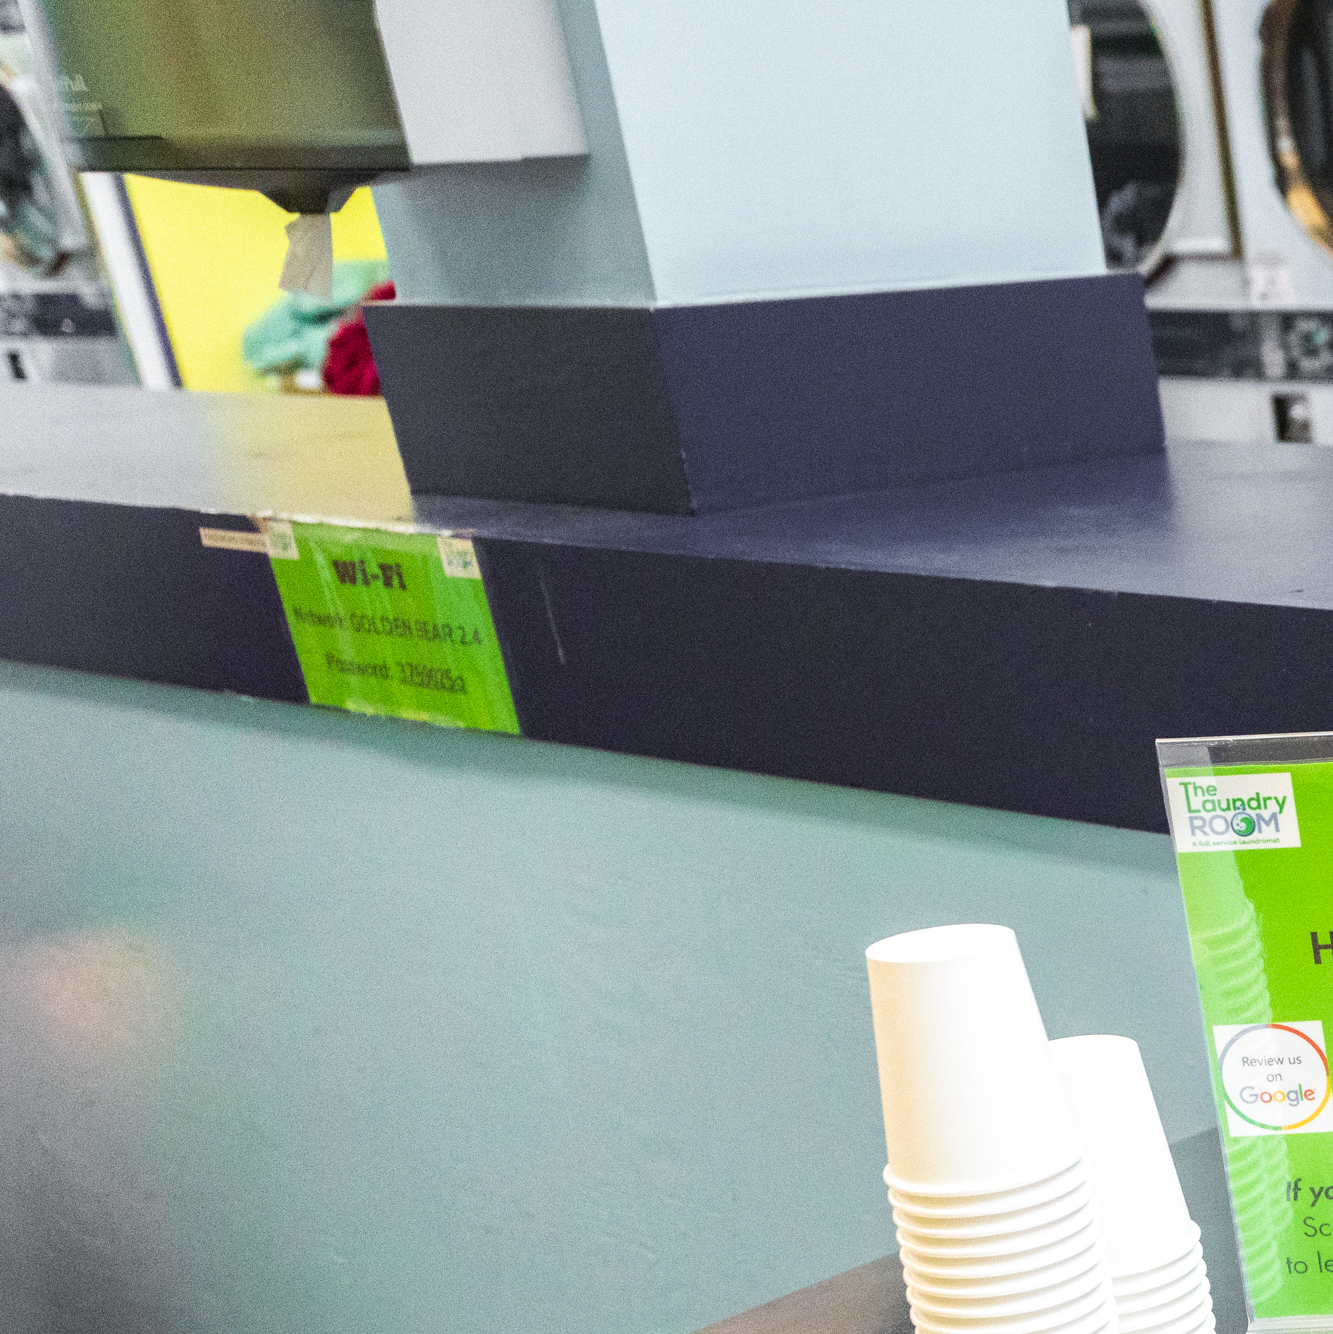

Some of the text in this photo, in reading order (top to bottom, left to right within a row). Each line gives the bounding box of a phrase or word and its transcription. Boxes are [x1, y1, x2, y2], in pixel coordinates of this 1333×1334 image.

[332, 559, 407, 590] Wi-Fi
[350, 613, 413, 637] GOLDEN
[415, 619, 453, 643] BEAR
[1179, 781, 1218, 798] The
[1186, 792, 1287, 814] Laundry
[1188, 811, 1280, 837] ROOM
[1238, 837, 1280, 845] laundromat
[1241, 1055, 1302, 1067] Review us
[1266, 1073, 1283, 1083] on
[1239, 1083, 1316, 1107] Google
[1286, 1177, 1302, 1202] If
[1286, 1256, 1308, 1275] to
